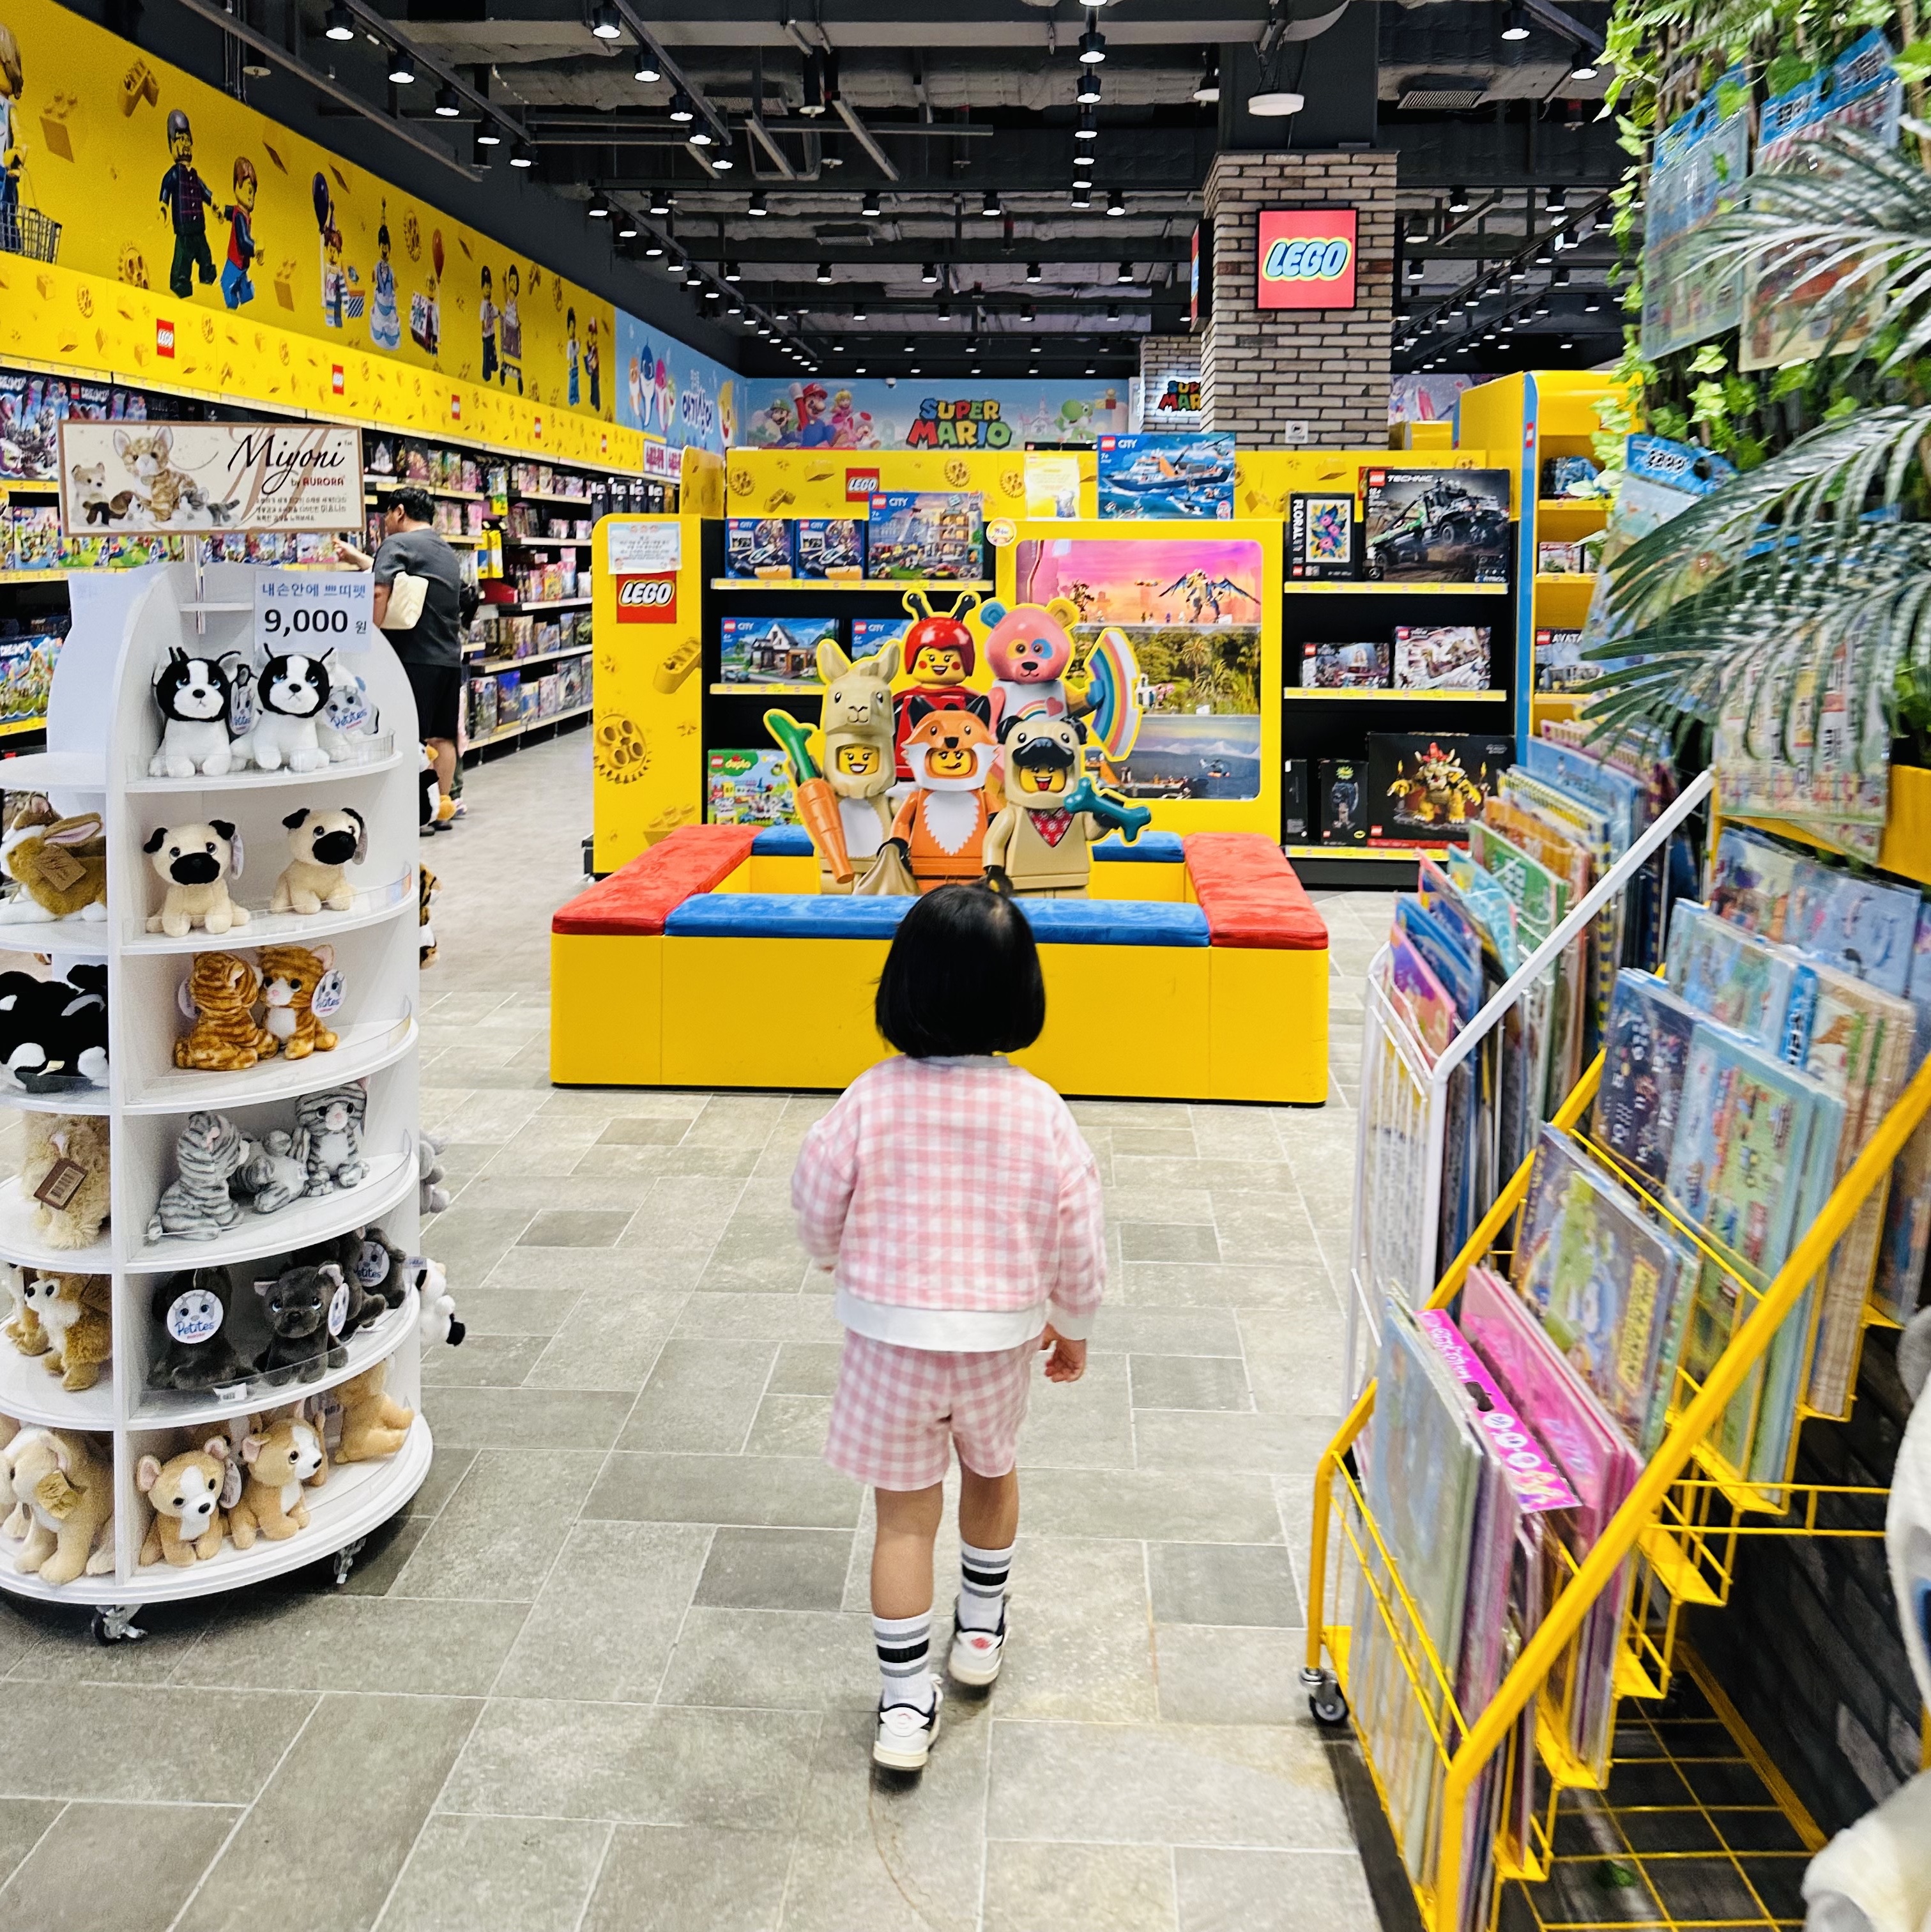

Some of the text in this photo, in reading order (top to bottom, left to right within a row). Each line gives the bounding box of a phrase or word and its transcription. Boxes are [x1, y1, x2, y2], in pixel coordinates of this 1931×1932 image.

[1264, 239, 1350, 279] LEGO
[1168, 380, 1201, 394] SUP
[919, 397, 1001, 421] SUPER
[1158, 394, 1201, 411] MAR
[907, 418, 1012, 449] MARIO
[1118, 439, 1138, 449] CITY
[227, 434, 345, 494] Miyoni
[303, 477, 344, 486] AURORA
[848, 477, 878, 491] LEGO
[889, 498, 908, 507] CITY
[263, 583, 319, 597] 내손안에
[620, 581, 673, 605] LEGO
[264, 609, 367, 637] 9,000 원
[1552, 633, 1583, 643] AVATA
[174, 1321, 215, 1337] Petites
